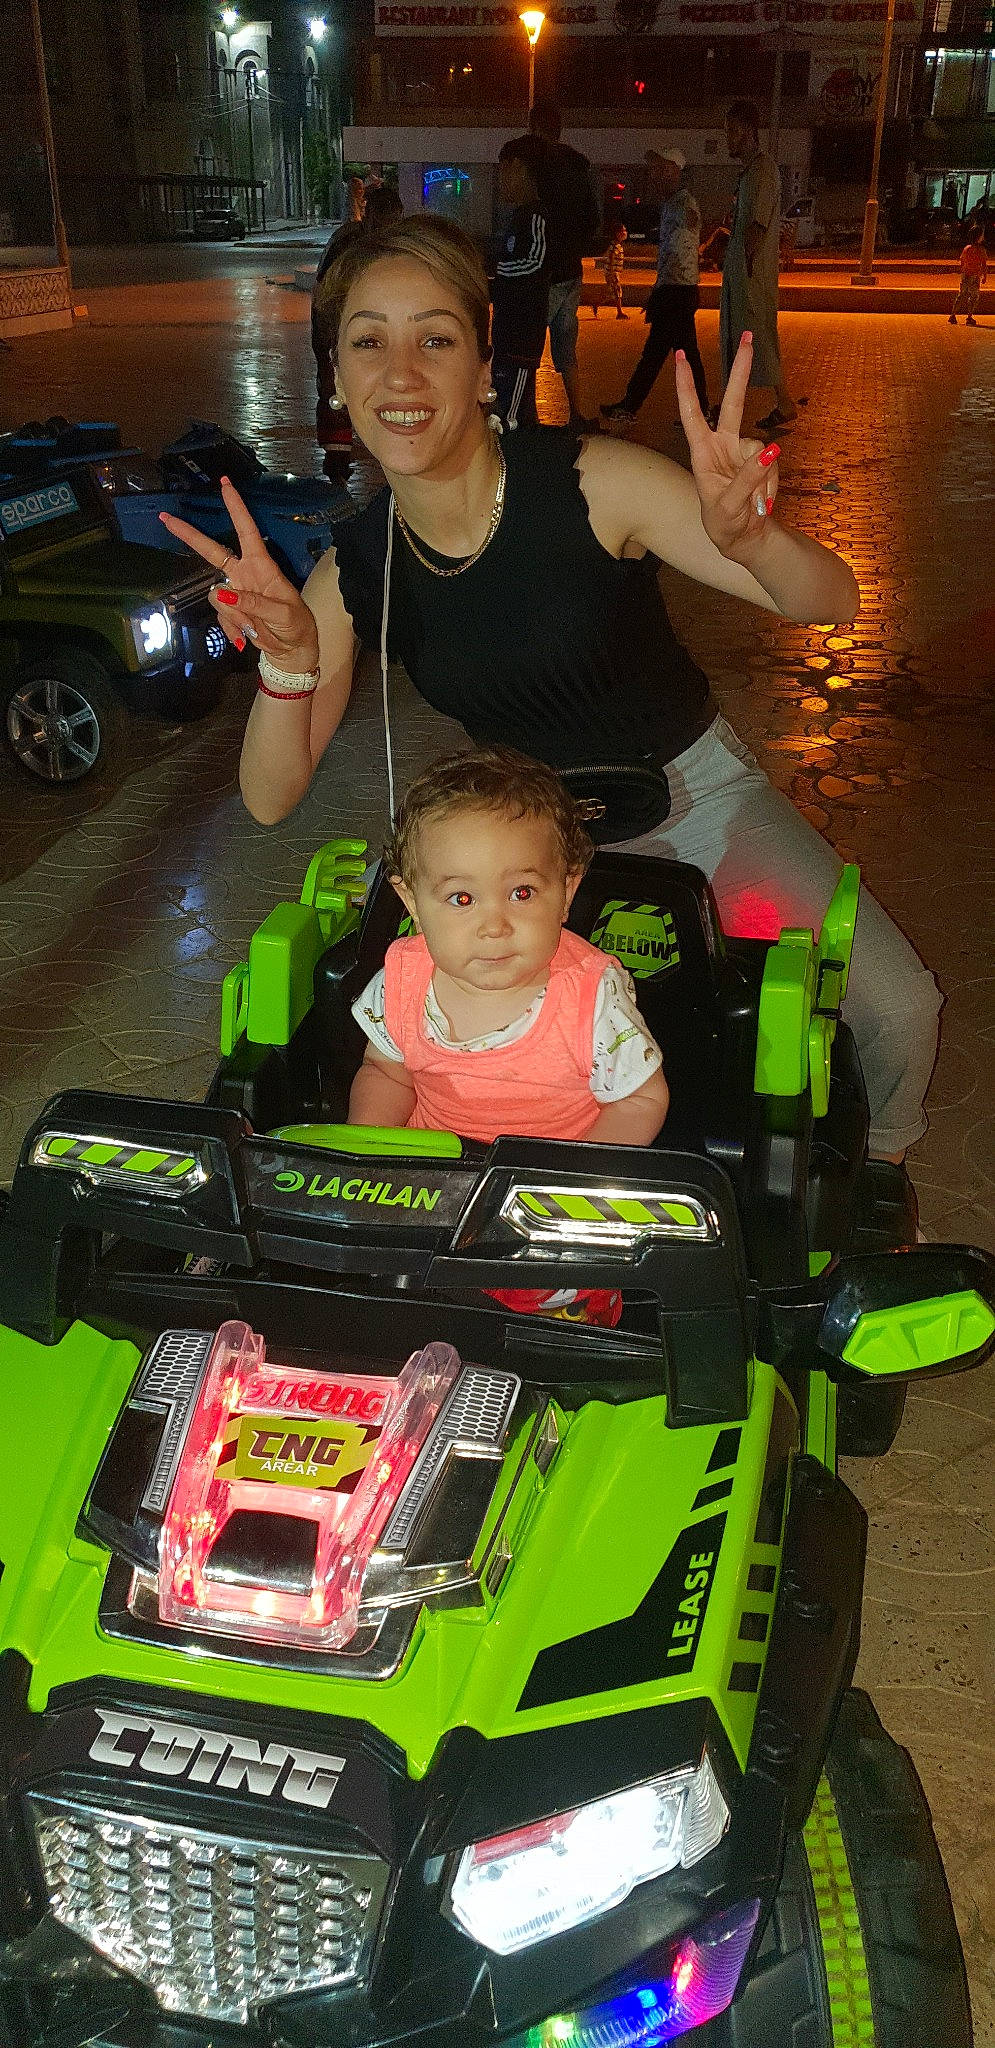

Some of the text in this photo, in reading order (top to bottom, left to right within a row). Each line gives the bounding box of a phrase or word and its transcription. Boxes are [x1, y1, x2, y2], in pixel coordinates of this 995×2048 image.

[379, 6, 478, 25] RESTAURANT
[2, 486, 71, 526] sparco
[601, 933, 671, 960] BELOW
[306, 1174, 441, 1211] LACHLAN
[241, 1379, 387, 1420] STRONG
[248, 1430, 345, 1468] CNG
[260, 1460, 319, 1477] AREAR
[667, 1551, 714, 1657] LEASE
[88, 1708, 346, 1808] COING
